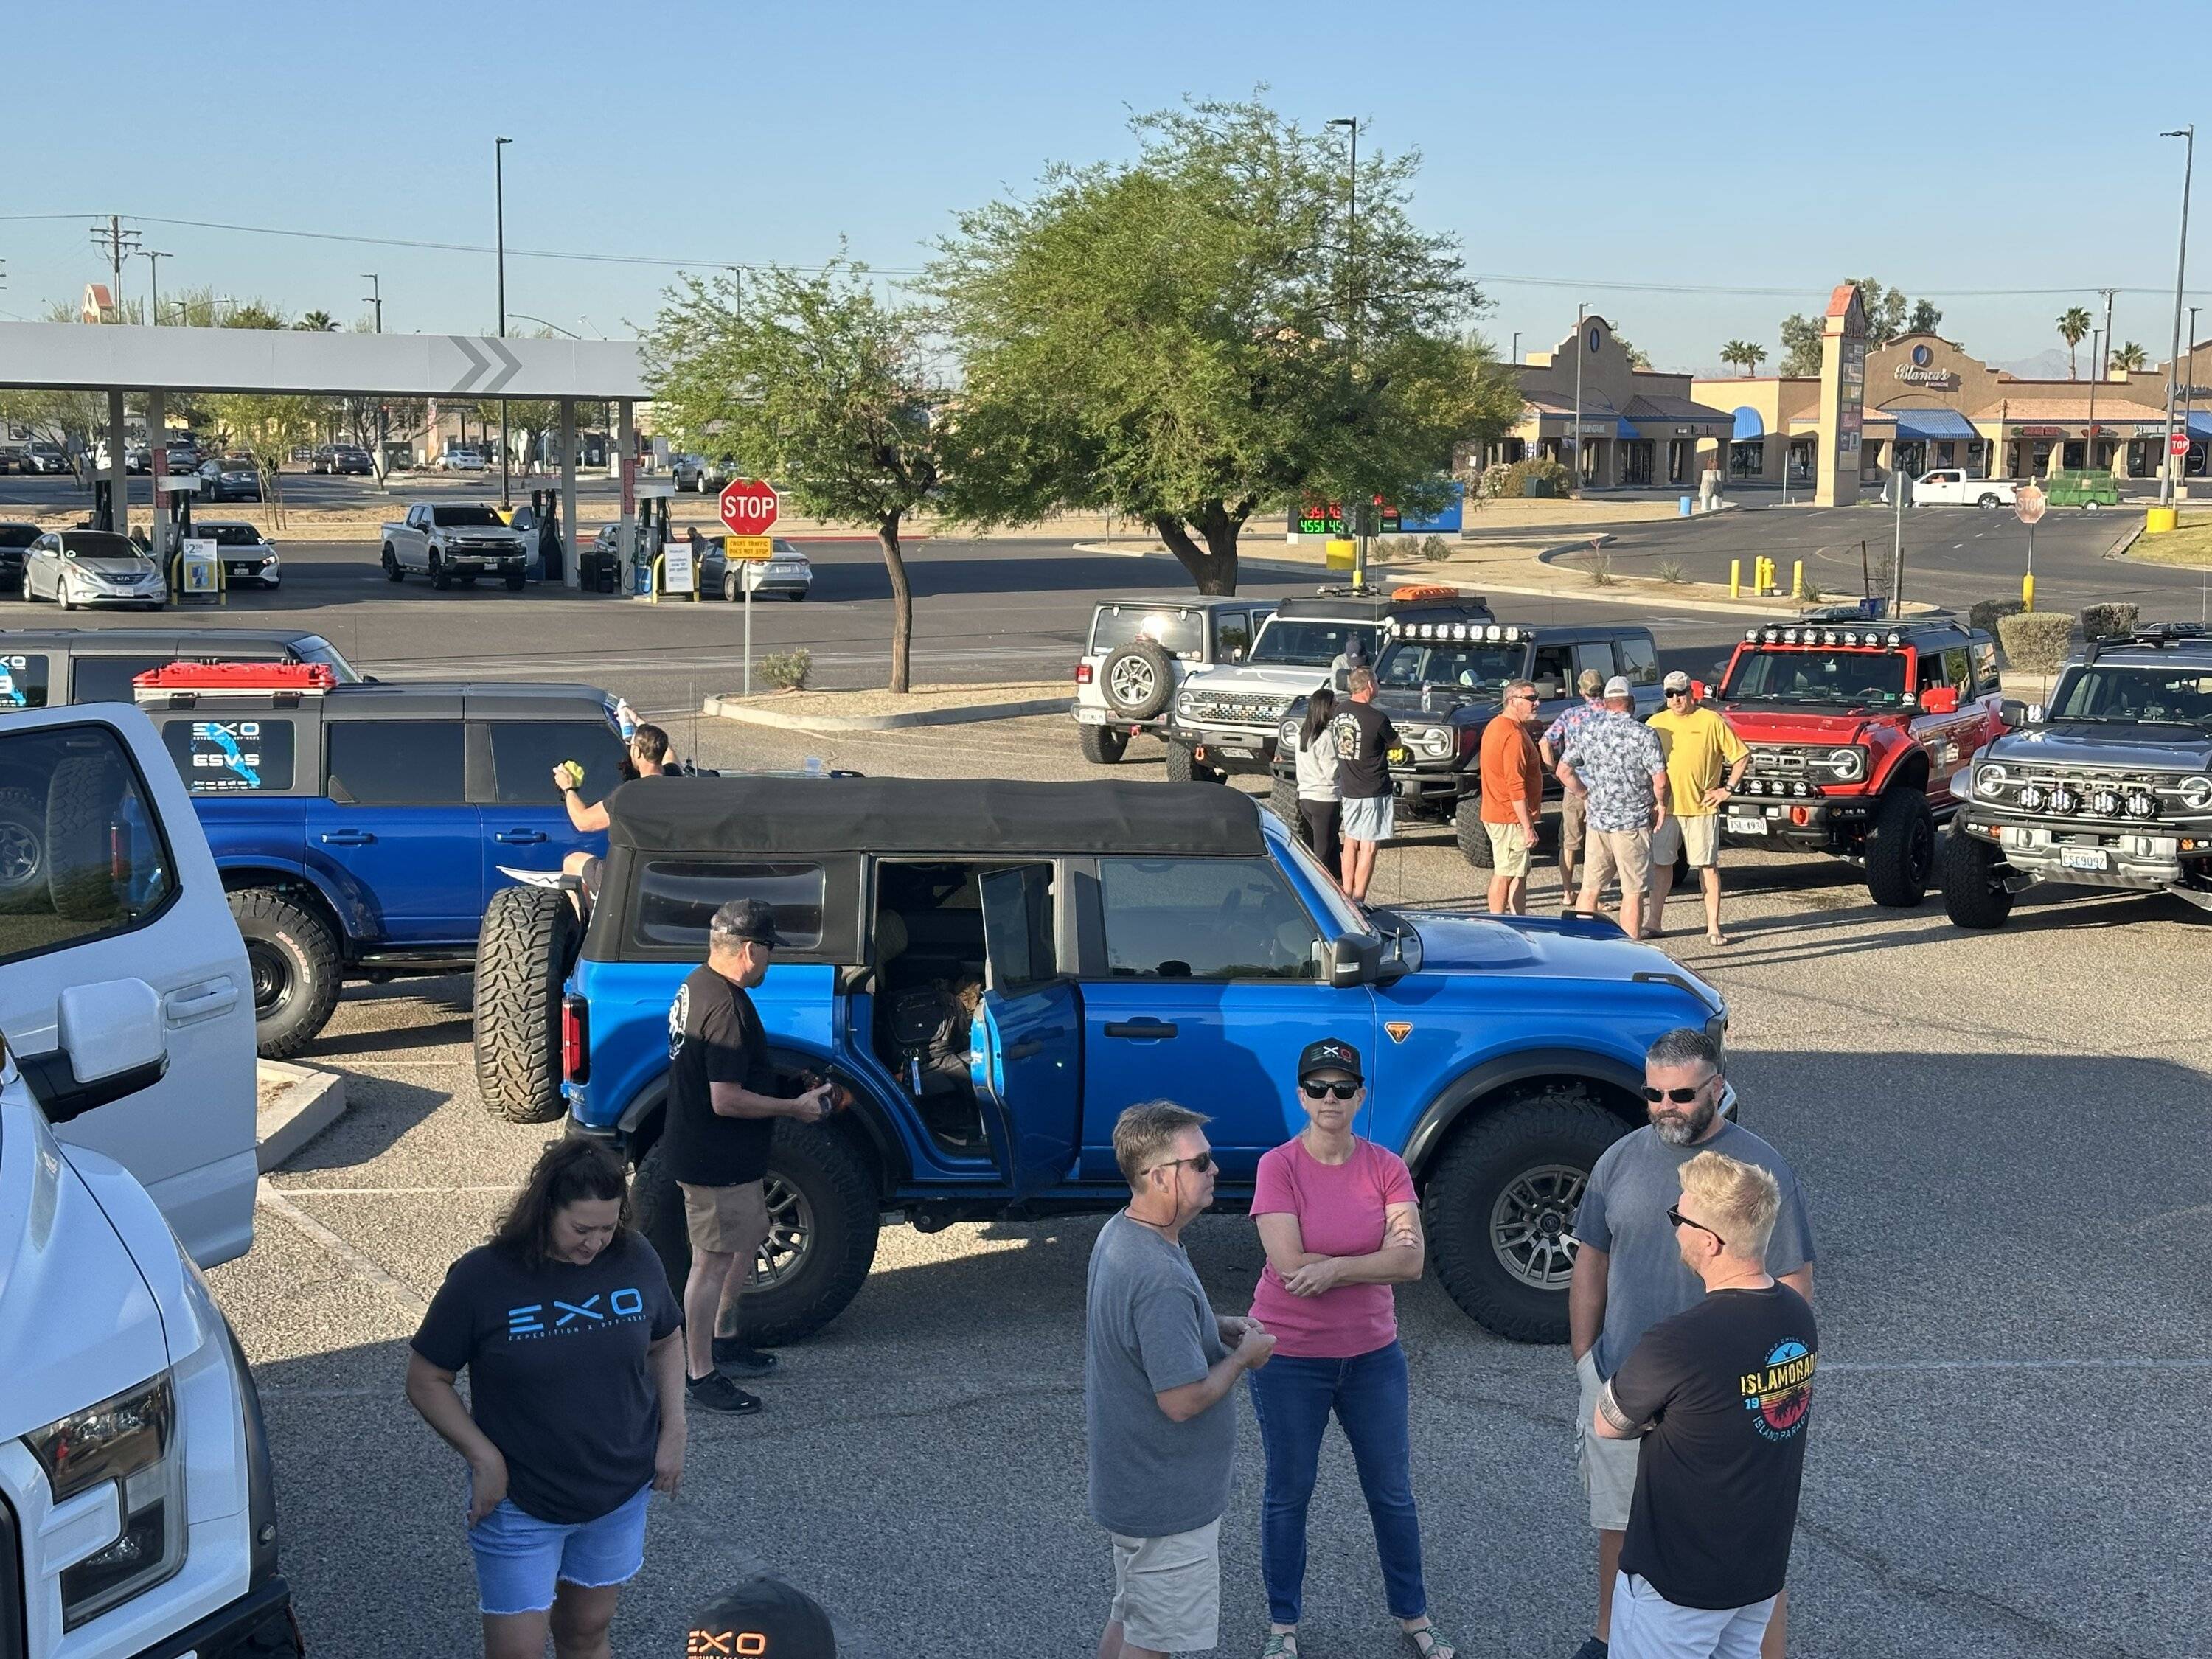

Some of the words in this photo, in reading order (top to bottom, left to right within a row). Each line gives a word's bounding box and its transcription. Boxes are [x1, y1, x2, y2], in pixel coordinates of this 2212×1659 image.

[724, 495, 775, 518] STOP
[2017, 498, 2043, 511] STOP
[192, 723, 260, 736] EXO
[1311, 1046, 1352, 1061] EXO
[509, 1288, 643, 1333] EXO
[509, 1327, 579, 1341] EXPEDITION
[1745, 1397, 1759, 1410] 19
[1753, 1416, 1779, 1441] ISLAND
